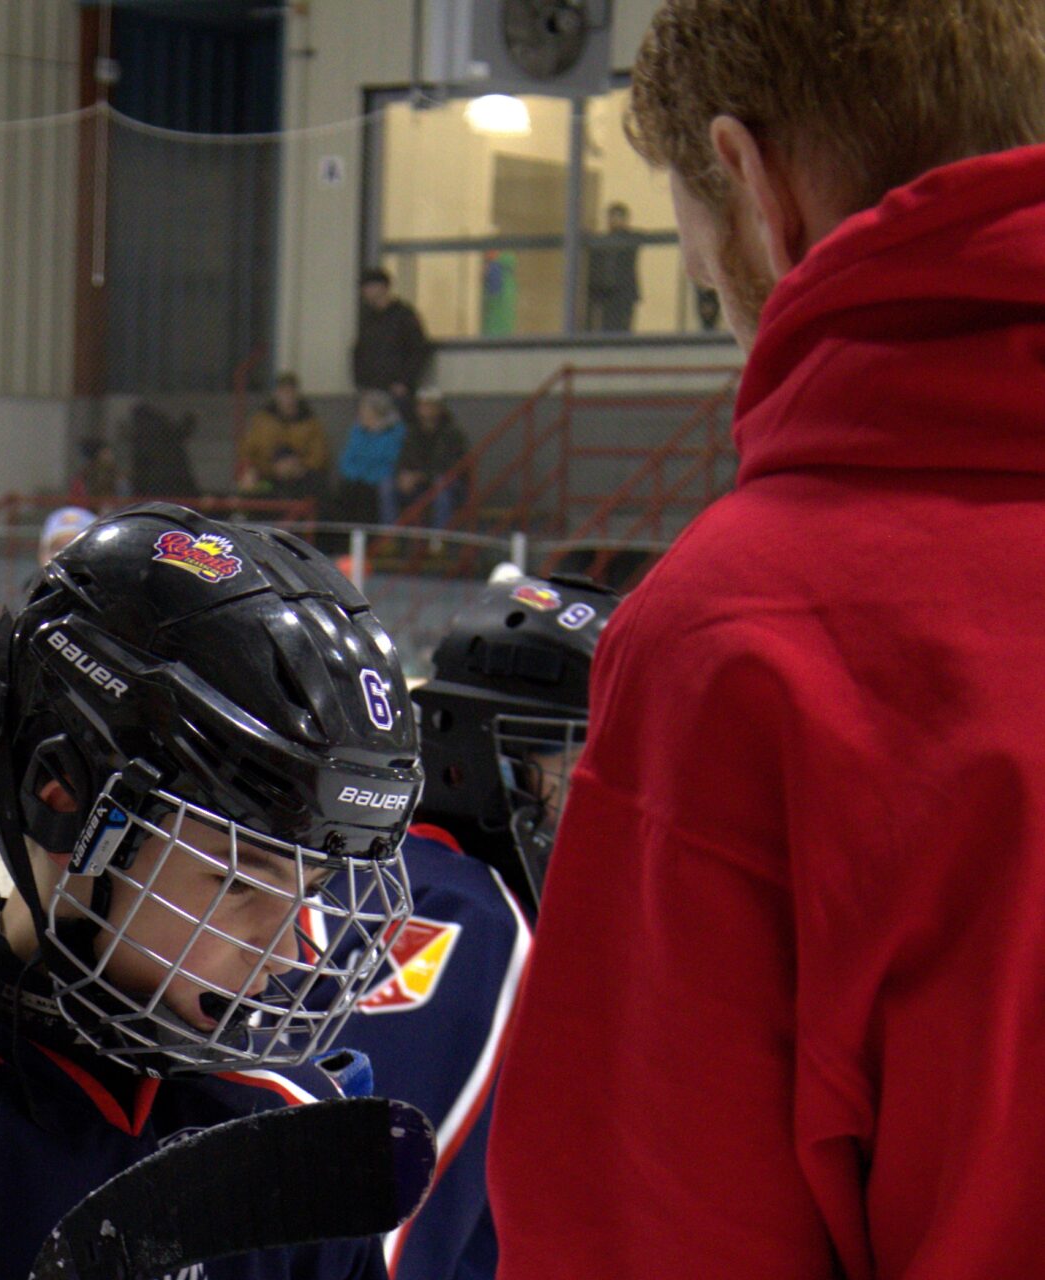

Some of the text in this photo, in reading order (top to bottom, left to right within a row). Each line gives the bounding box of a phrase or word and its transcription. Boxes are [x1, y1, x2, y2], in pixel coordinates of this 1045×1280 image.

[47, 631, 129, 698] BAUER
[359, 668, 393, 731] 6
[338, 786, 409, 810] BAUER
